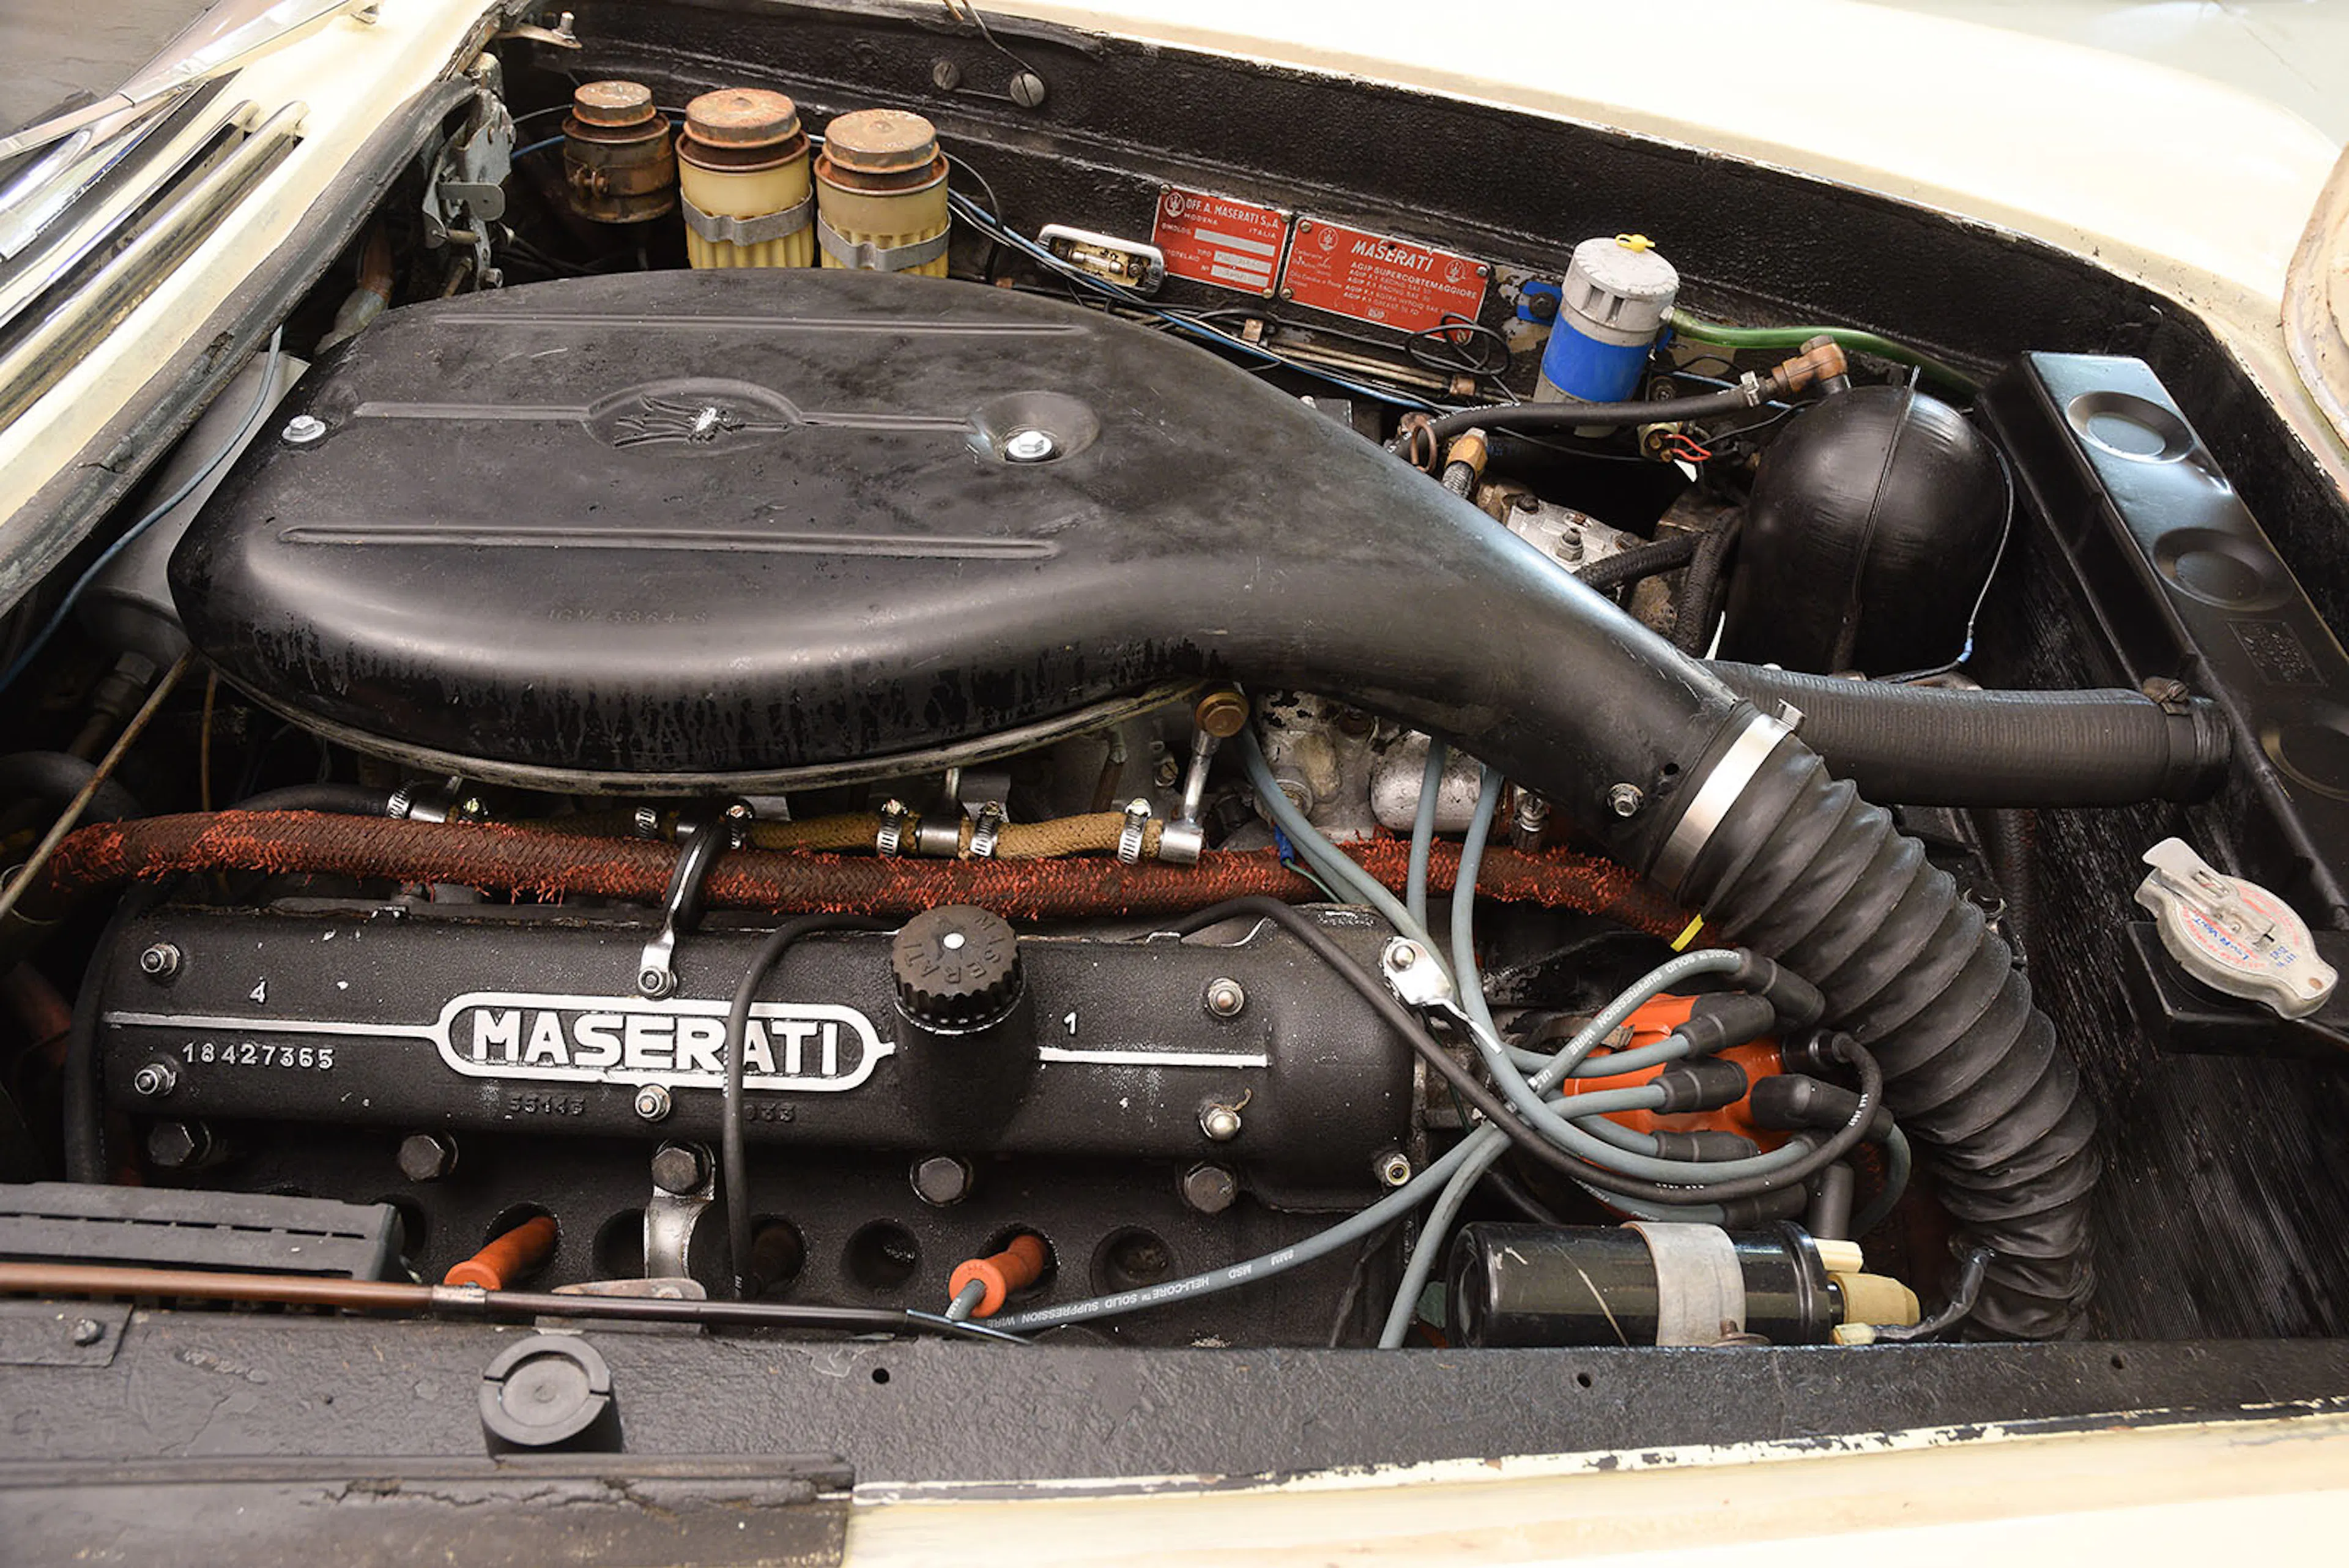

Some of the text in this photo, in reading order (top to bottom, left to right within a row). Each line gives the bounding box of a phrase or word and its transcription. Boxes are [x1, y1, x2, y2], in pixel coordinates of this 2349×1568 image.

[1183, 213, 1219, 225] MODENA
[1214, 205, 1260, 223] MASERATI
[1248, 228, 1276, 239] ITALIA
[1350, 261, 1373, 272] AGIP
[1351, 239, 1434, 272] MASERATI
[249, 980, 267, 1003] 4
[1595, 970, 1663, 1028] SUPPRESSION
[1063, 1011, 1077, 1035] 1
[473, 1009, 838, 1076] MASERATI
[1567, 1027, 1597, 1056] WIRE
[183, 1042, 335, 1069] 18427365
[1228, 1263, 1252, 1280] MSD
[1021, 1301, 1099, 1324] SUPPRESSION
[1105, 1293, 1137, 1309] SOLID
